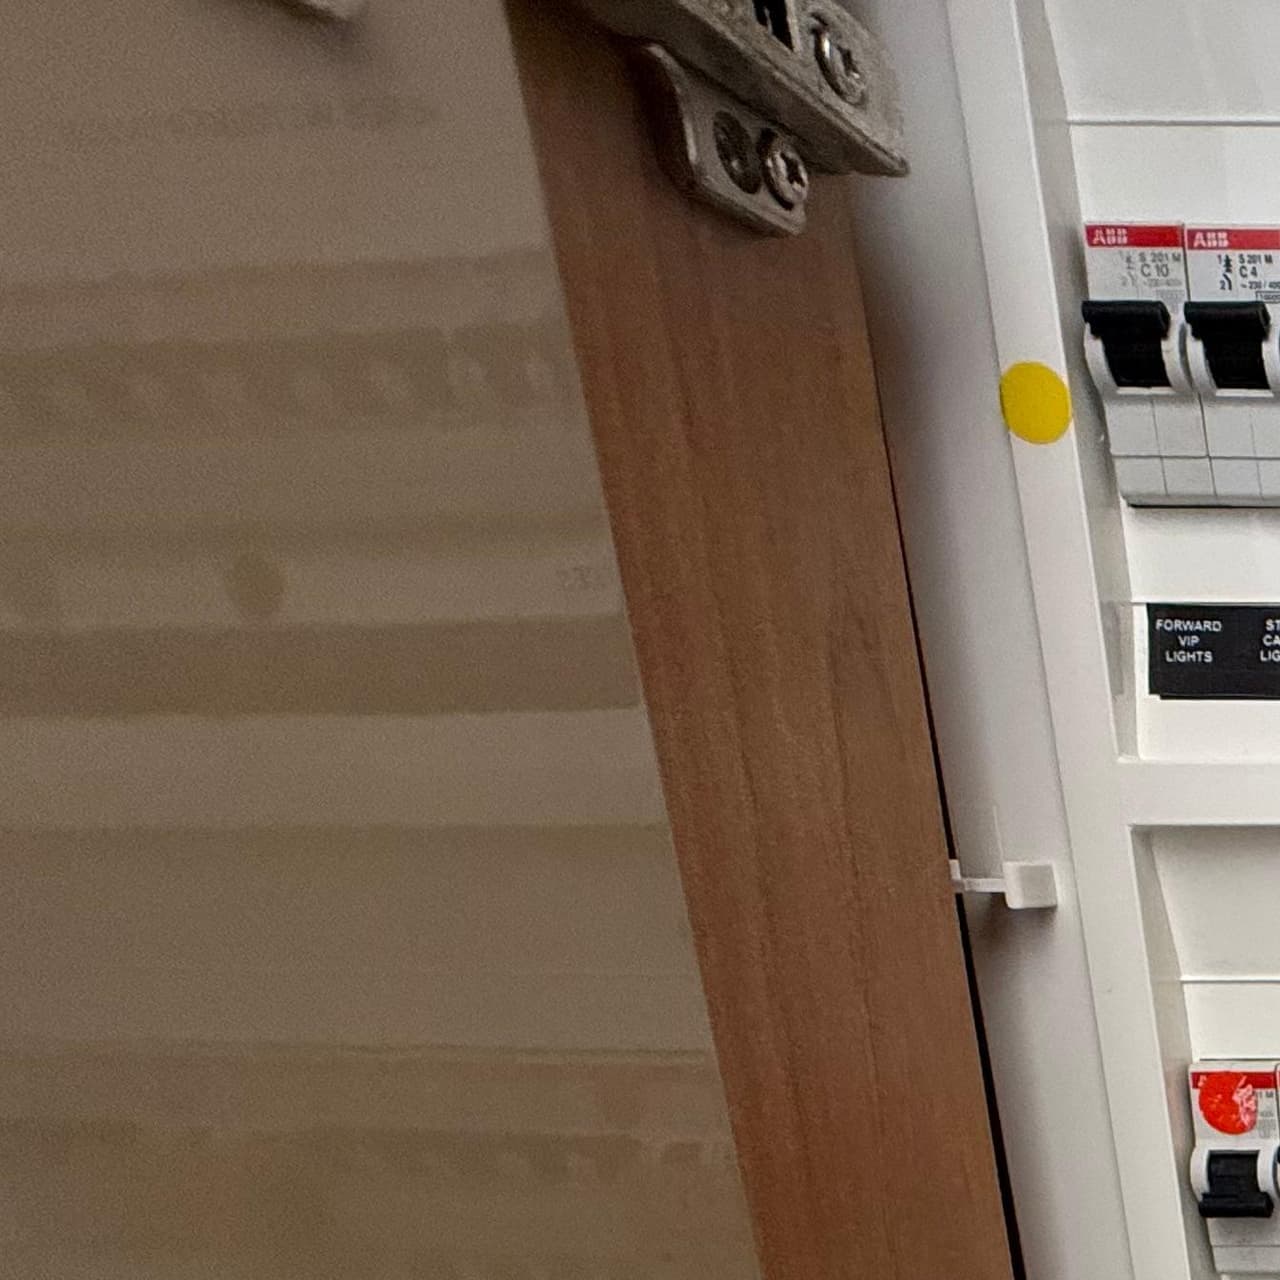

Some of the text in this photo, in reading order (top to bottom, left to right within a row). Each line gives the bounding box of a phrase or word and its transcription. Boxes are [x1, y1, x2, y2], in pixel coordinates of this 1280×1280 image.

[1093, 228, 1127, 245] ABB
[1194, 232, 1229, 247] ABB
[1156, 619, 1222, 632] FORWARD
[1178, 635, 1200, 646] VIP
[1165, 650, 1213, 663] LIGHTS
